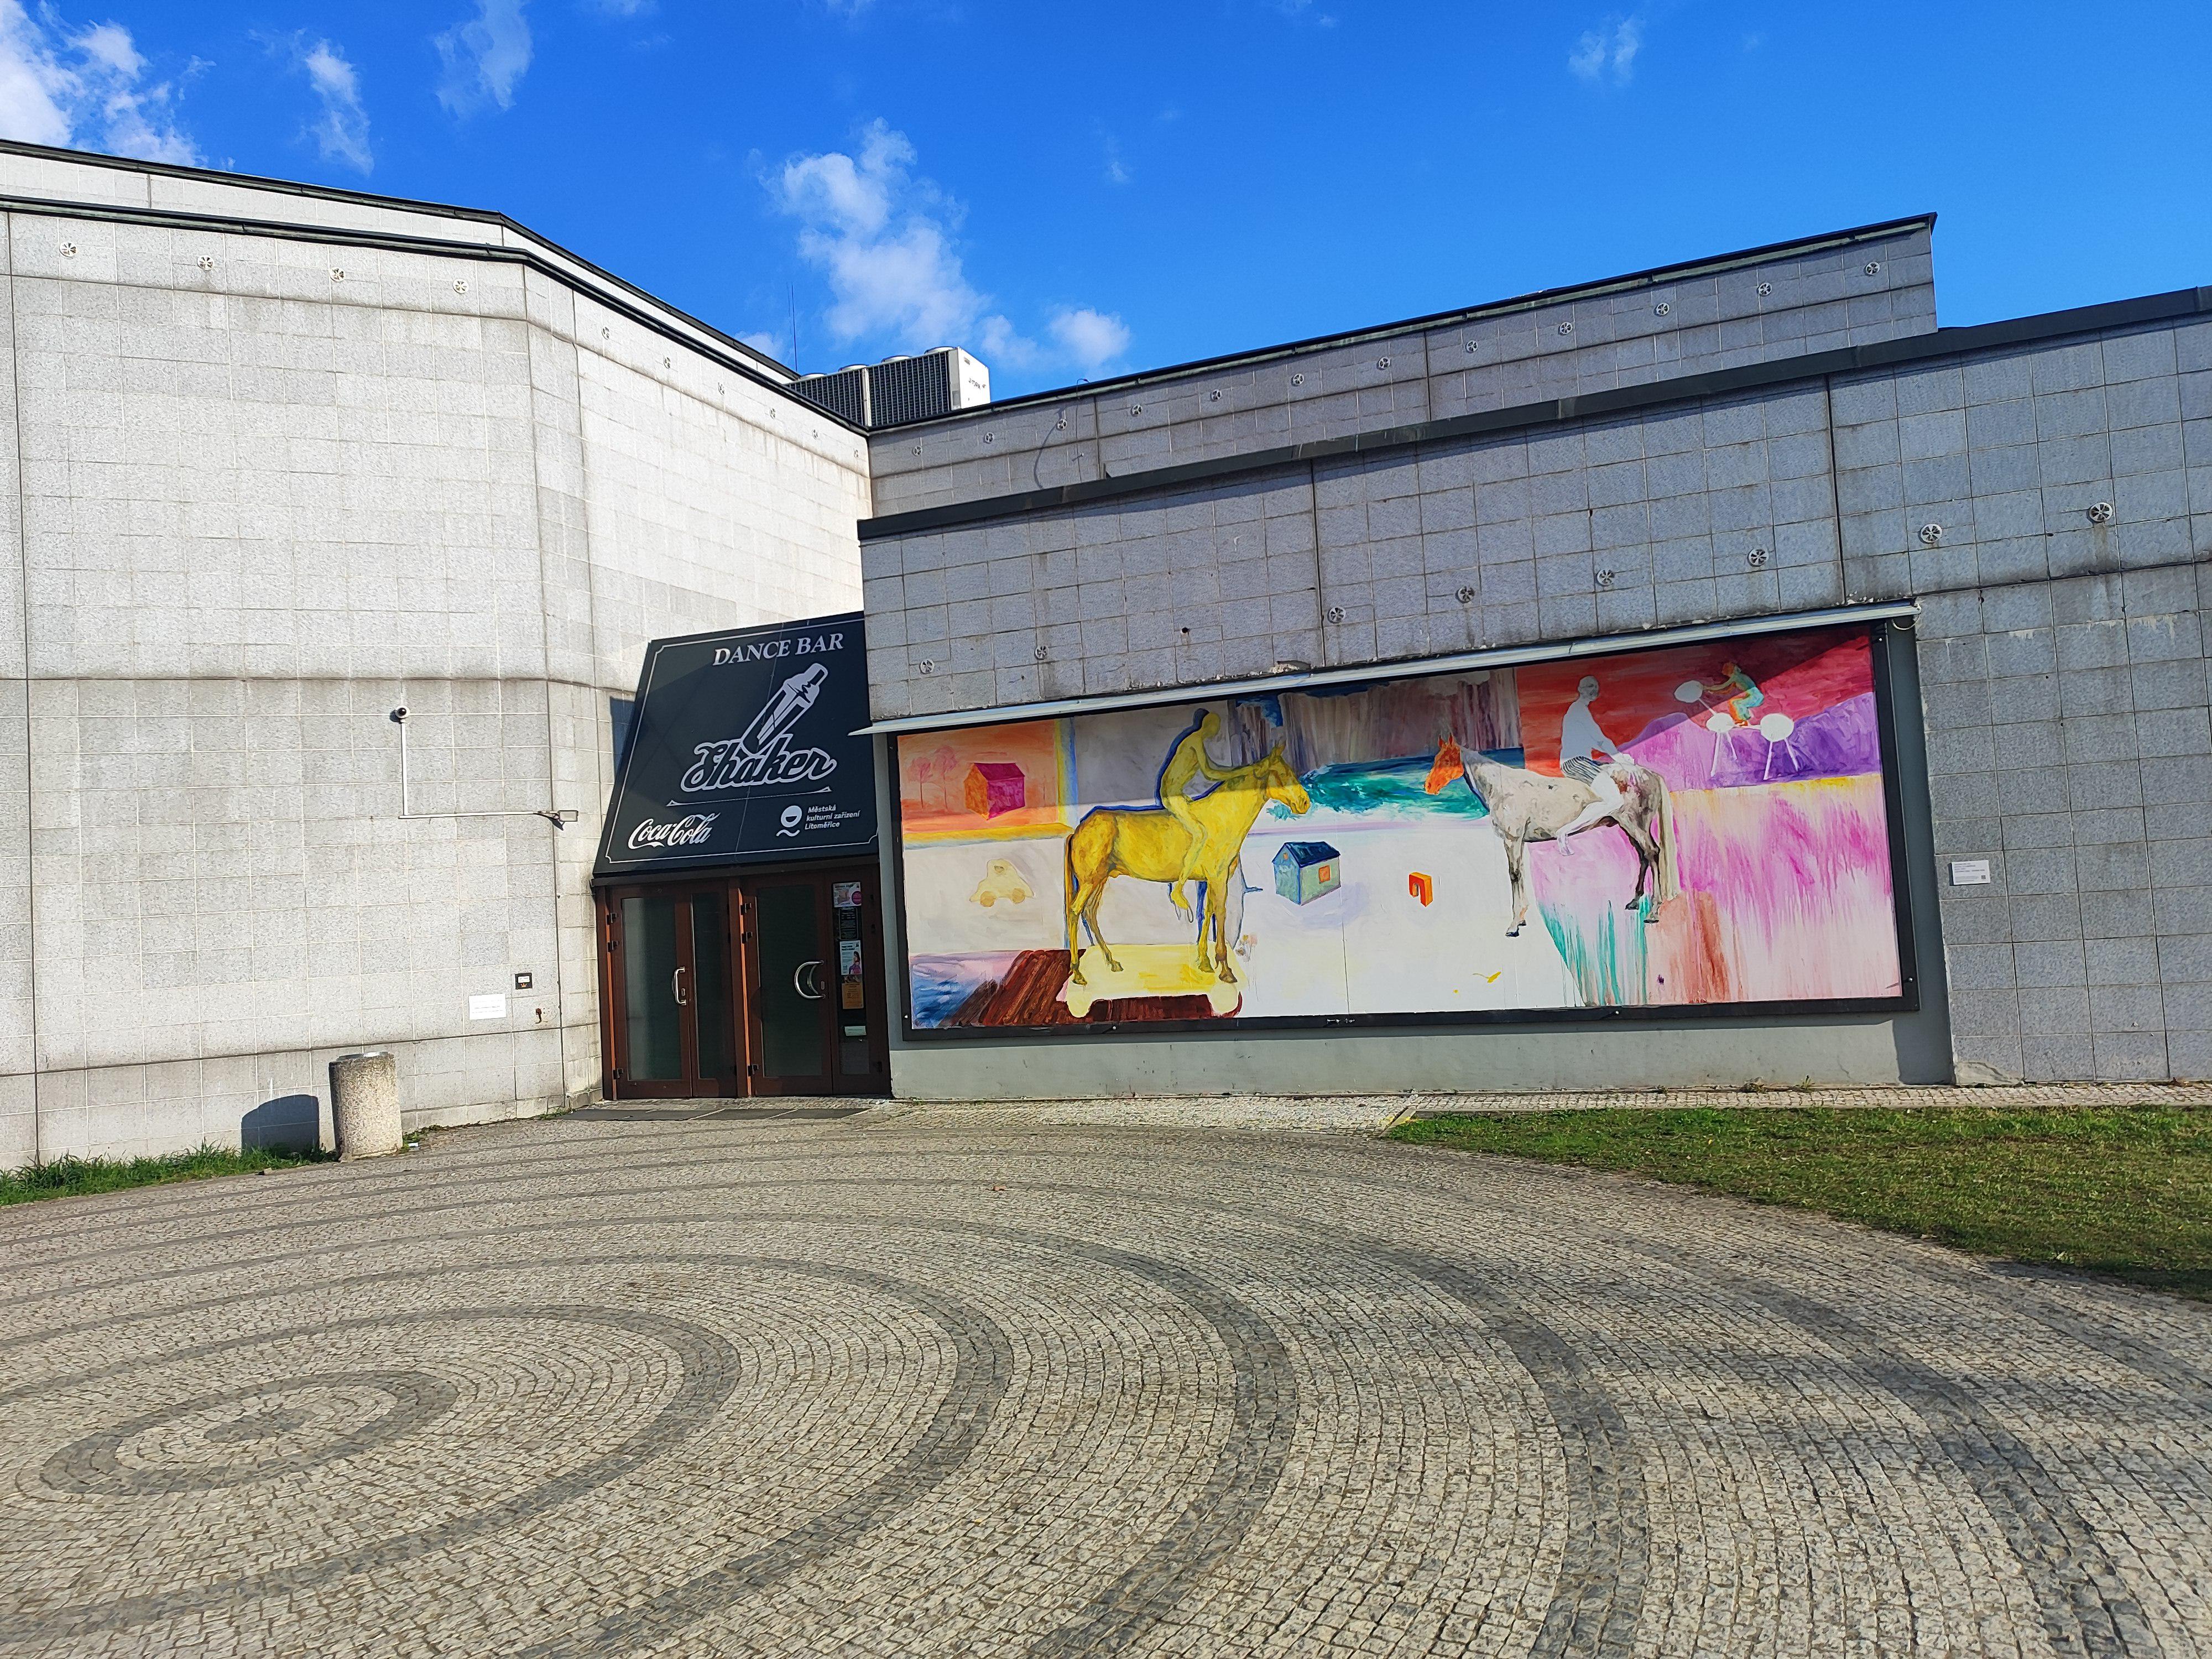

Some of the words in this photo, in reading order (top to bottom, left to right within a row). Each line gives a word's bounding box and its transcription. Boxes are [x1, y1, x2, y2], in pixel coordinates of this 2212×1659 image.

[713, 640, 791, 666] DANCE
[795, 633, 844, 655] BAR
[680, 734, 837, 792] Shaker
[806, 812, 833, 822] kulturní
[834, 810, 861, 819] zařízení
[808, 805, 836, 813] Městská
[628, 812, 721, 849] Coca-Cola
[805, 821, 840, 830] Litoměřice
